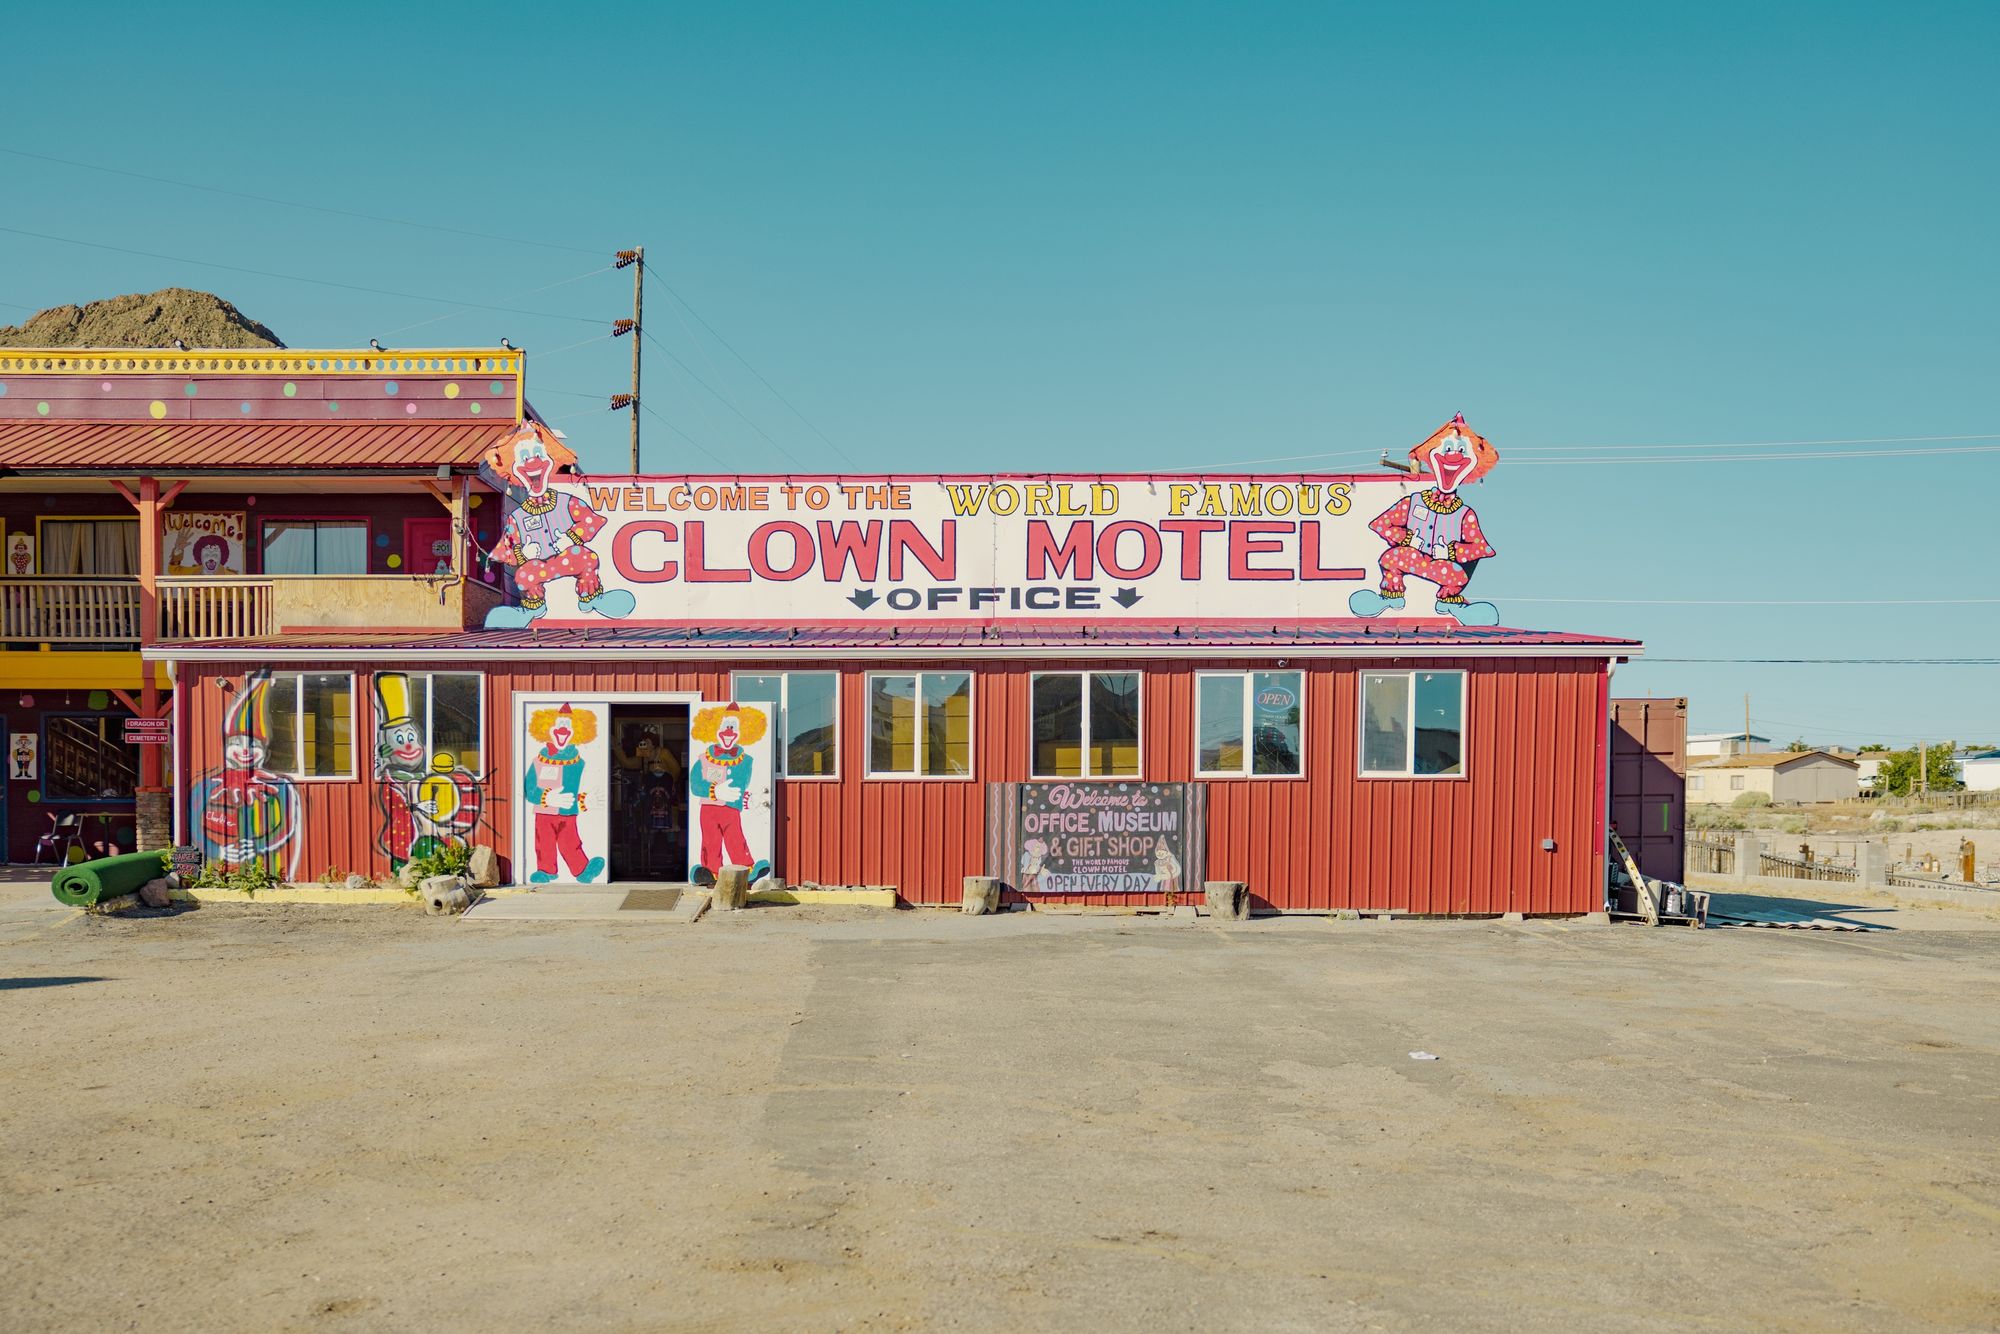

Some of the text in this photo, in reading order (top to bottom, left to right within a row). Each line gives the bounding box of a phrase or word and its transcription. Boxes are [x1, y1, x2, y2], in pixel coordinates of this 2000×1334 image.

[589, 483, 1352, 516] WELCOME TO THE WORLD FAMOUS
[611, 519, 1366, 584] CLOWN MOTEL
[886, 586, 1101, 611] OFFICE
[1257, 693, 1291, 706] OPEN
[1048, 784, 1148, 809] Welcome to
[1024, 810, 1178, 835] OFFICE, MUSEUM
[1051, 836, 1154, 857] & GIFT SHOP
[1046, 874, 1151, 891] OPEN EVERY DAY
